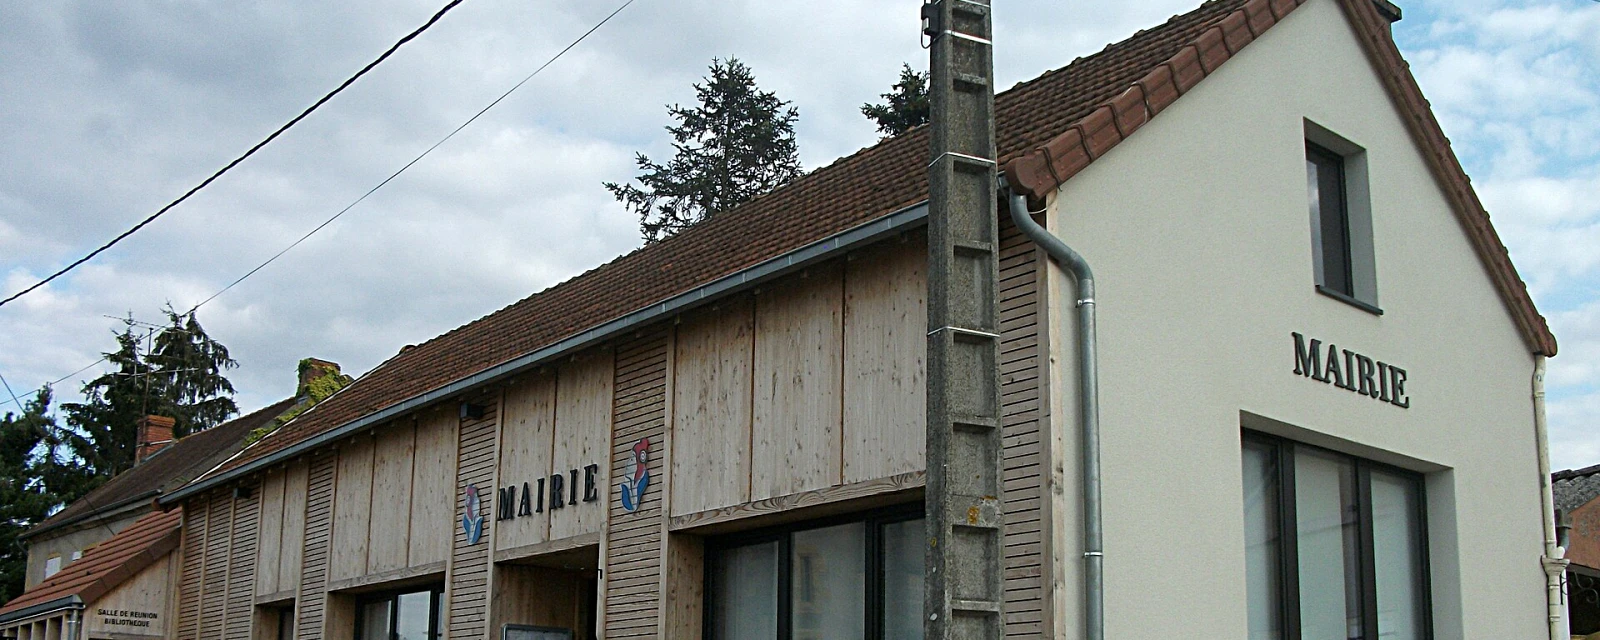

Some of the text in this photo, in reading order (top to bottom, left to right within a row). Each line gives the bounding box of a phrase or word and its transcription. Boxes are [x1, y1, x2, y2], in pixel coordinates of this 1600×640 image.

[1291, 331, 1410, 409] MAIRIE
[497, 463, 598, 521] MAIRIE
[97, 608, 118, 617] SALLE
[119, 610, 129, 618] DE
